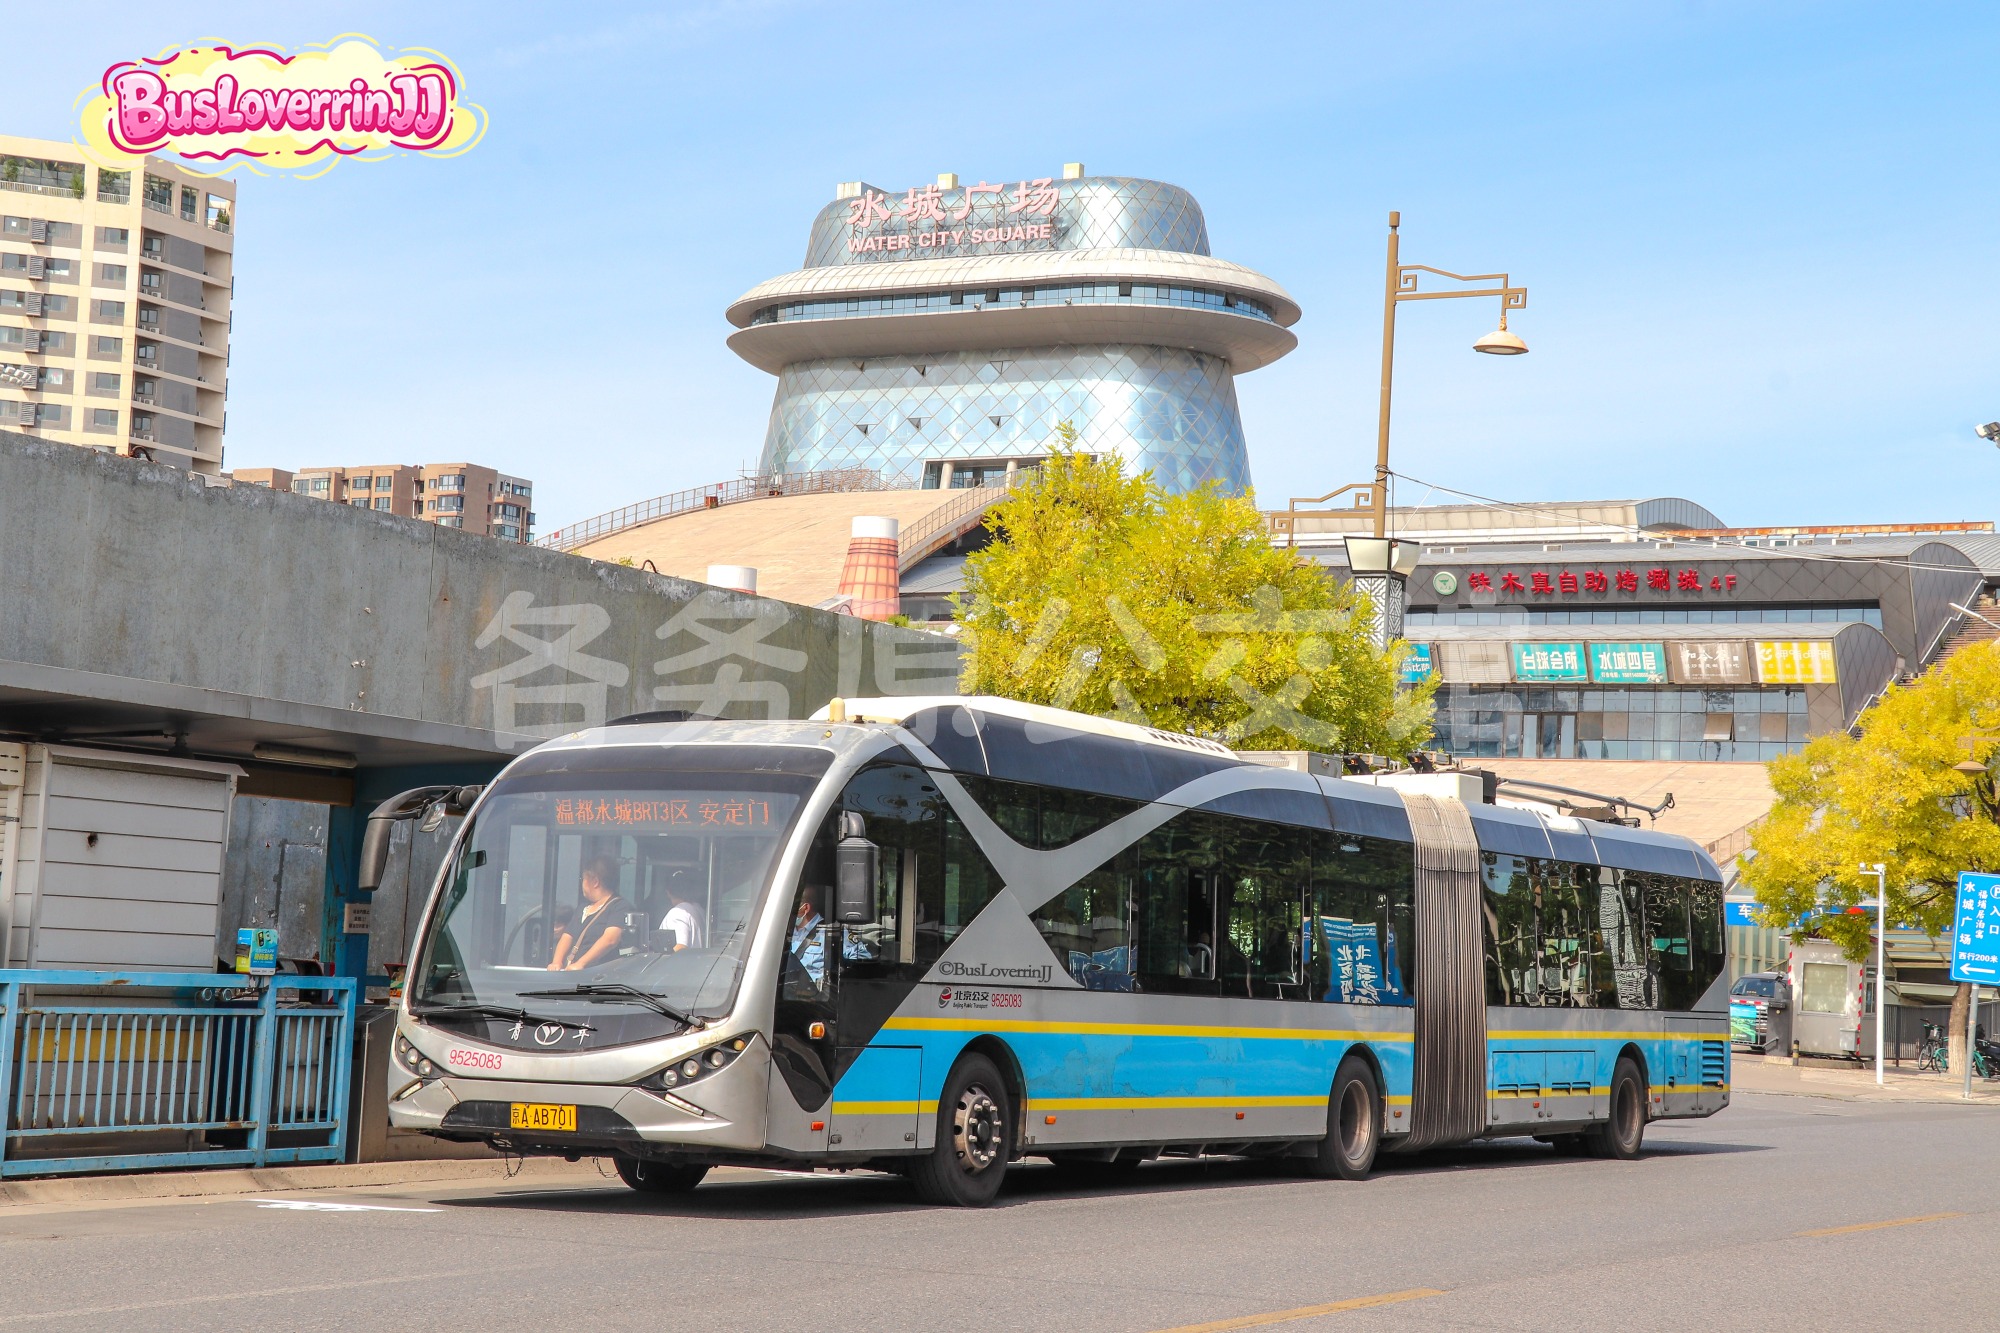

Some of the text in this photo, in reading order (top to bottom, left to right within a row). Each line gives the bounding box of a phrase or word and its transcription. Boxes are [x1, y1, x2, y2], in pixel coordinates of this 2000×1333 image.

[846, 178, 1060, 228] 水城广场
[848, 223, 1054, 252] WATER CITY SQUARE
[1467, 568, 1737, 594] 铁木真自助烤涮城 4F
[1522, 651, 1578, 670] 台球会所
[1598, 651, 1657, 670] 水城四层
[555, 798, 769, 826] 温都水城BRT3区 安定门
[1959, 881, 1976, 946] 水城广场
[1958, 951, 1999, 963] 西行200米
[954, 990, 989, 1001] 北京公交
[991, 993, 1022, 1008] 9525083
[449, 1049, 503, 1070] 9525083
